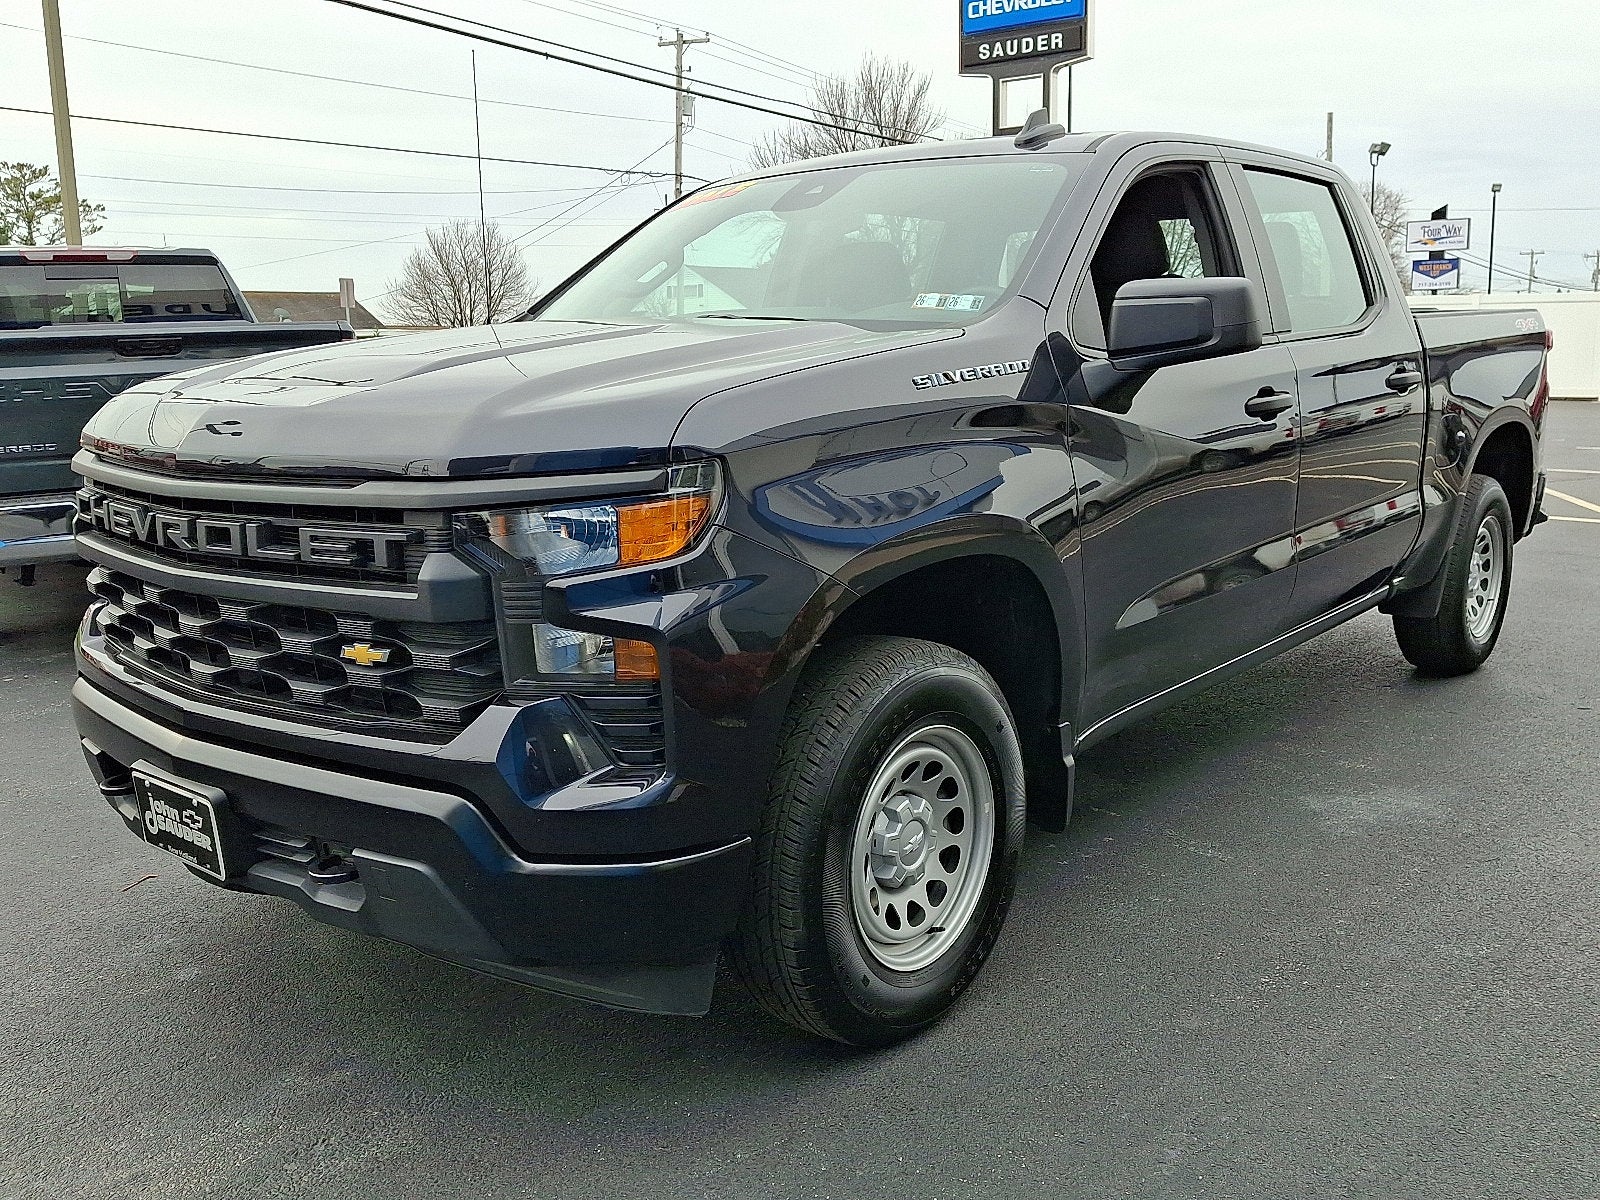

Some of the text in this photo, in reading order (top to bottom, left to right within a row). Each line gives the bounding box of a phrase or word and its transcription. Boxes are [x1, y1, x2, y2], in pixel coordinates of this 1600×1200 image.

[978, 32, 1063, 60] SAUDER
[1421, 224, 1462, 238] FOUR WAY
[912, 359, 1030, 391] SILVERADO
[76, 487, 425, 568] CHEVROLET
[156, 814, 213, 852] SAUDER
